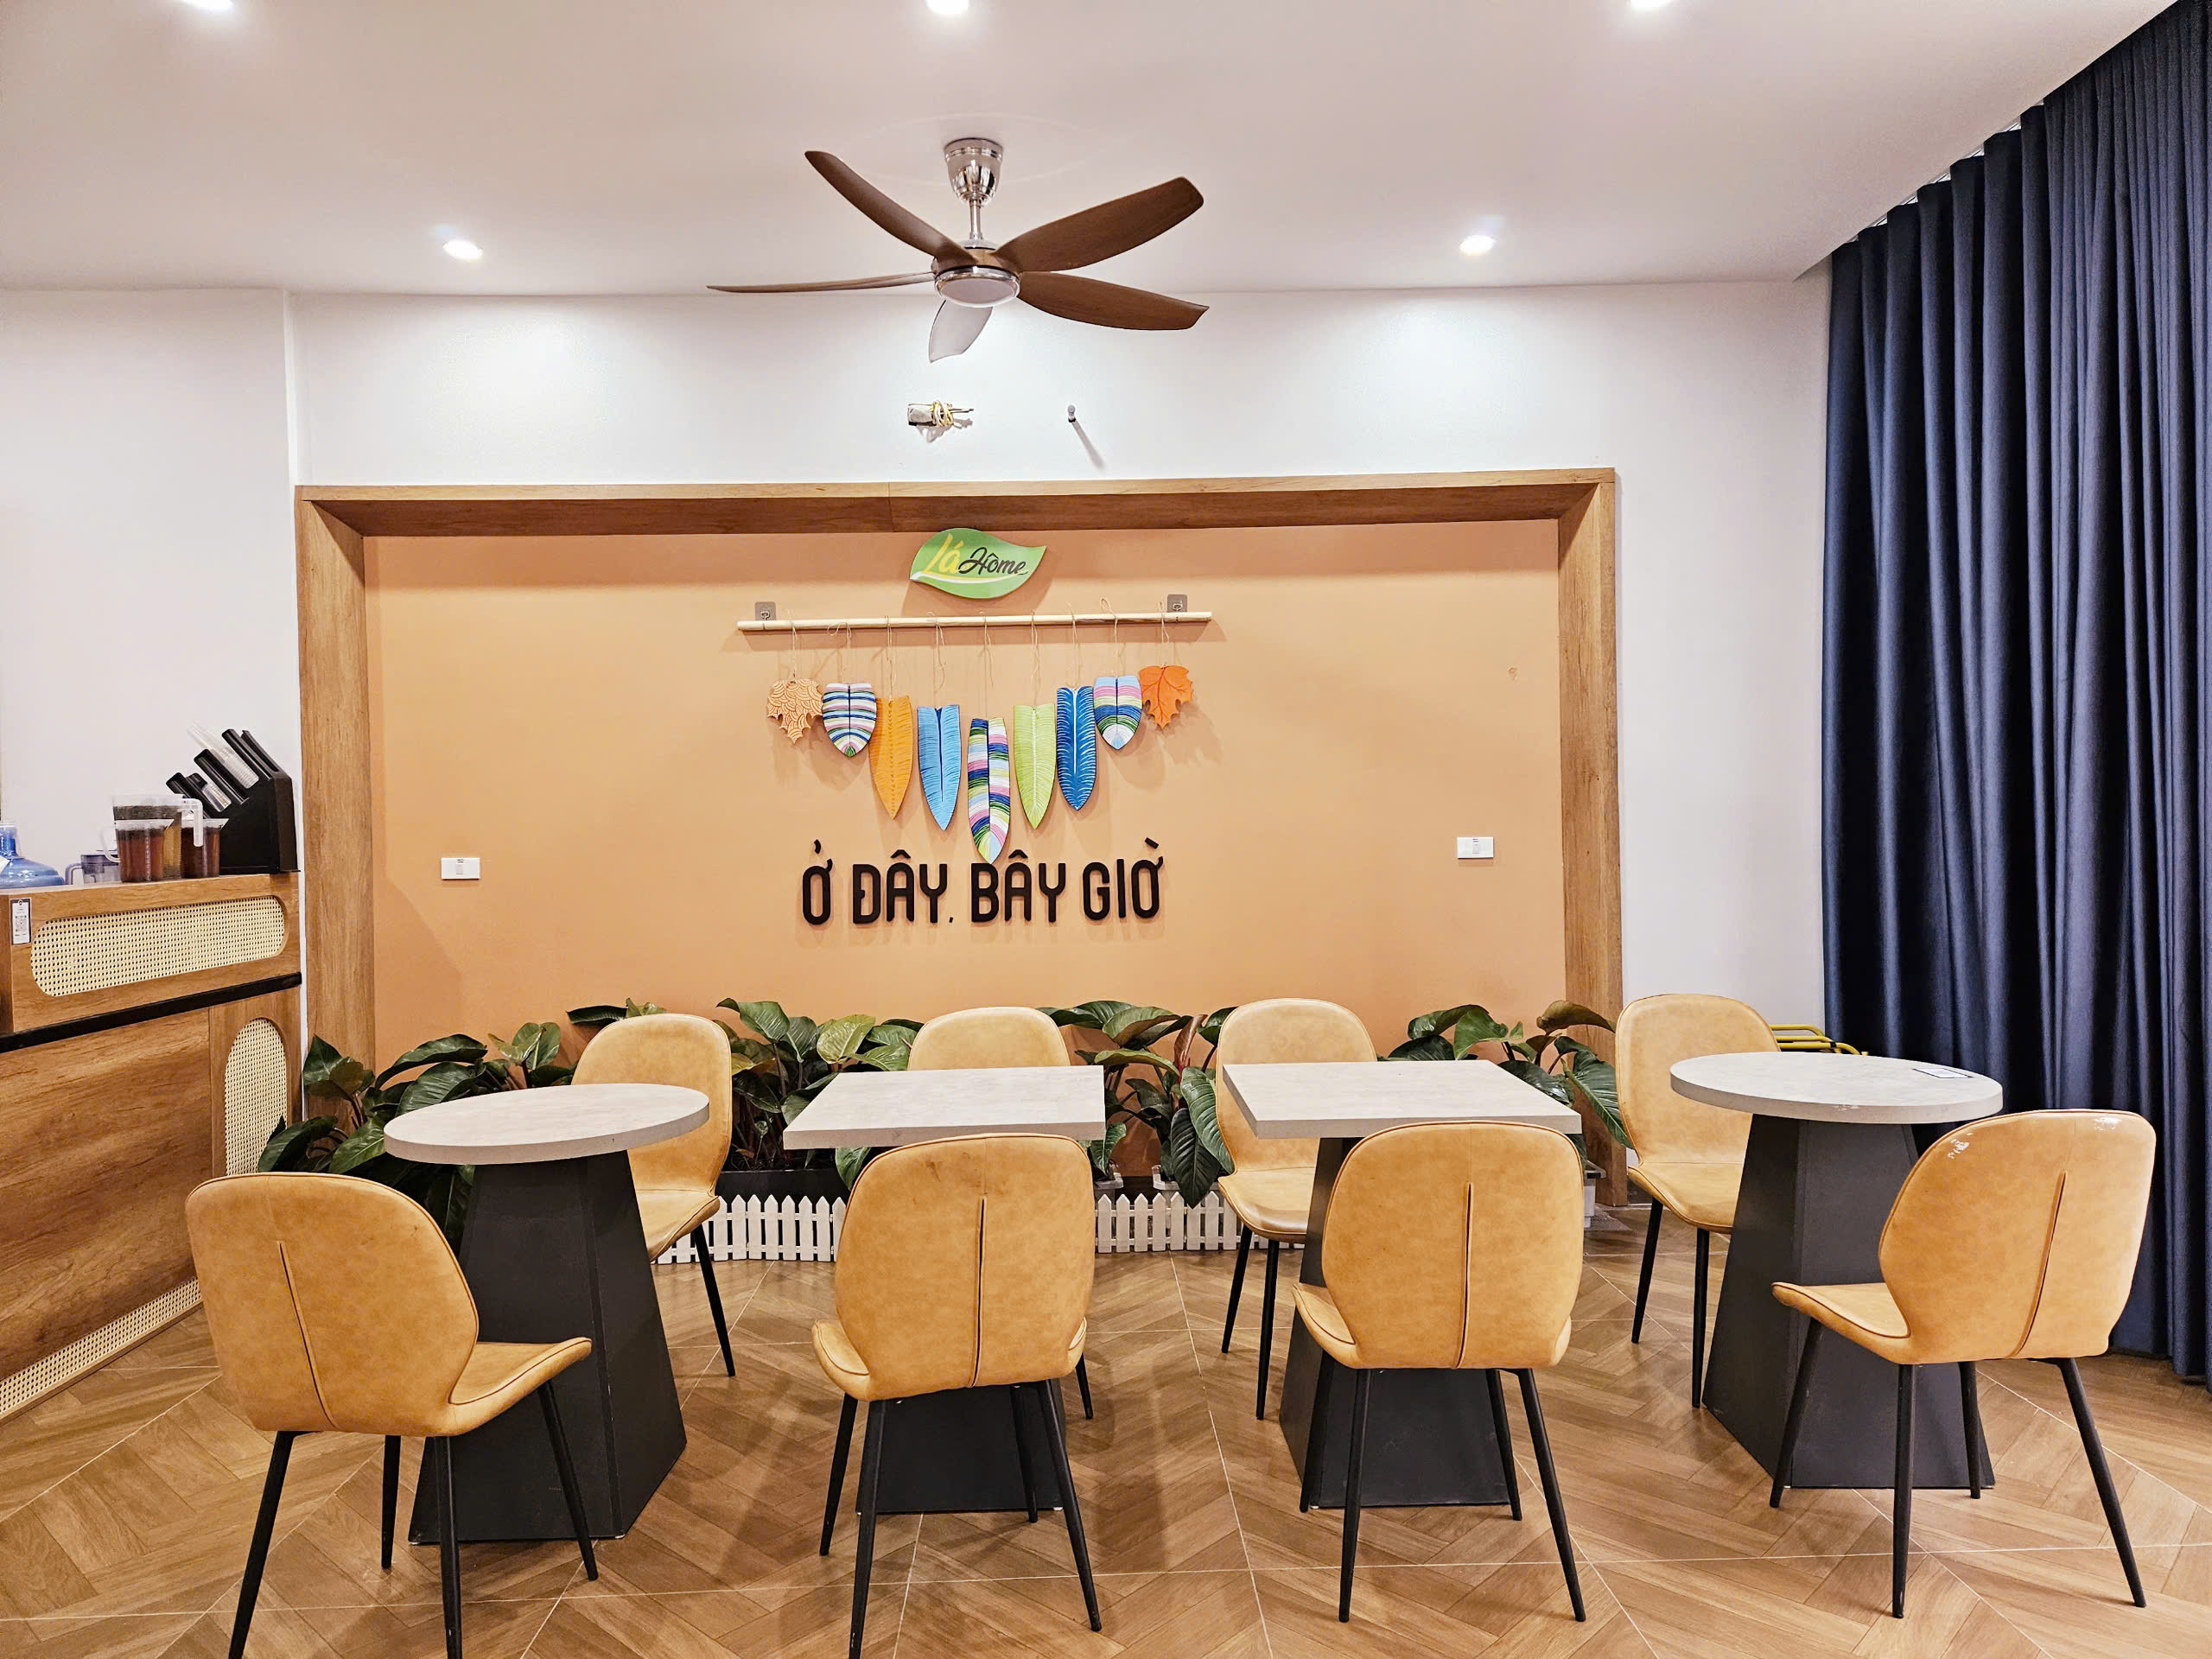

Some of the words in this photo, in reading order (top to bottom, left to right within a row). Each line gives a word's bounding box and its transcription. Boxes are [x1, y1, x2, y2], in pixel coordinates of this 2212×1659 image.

[802, 839, 834, 925] Ở
[971, 849, 1066, 924] BÂY
[1082, 836, 1165, 921] GIỜ
